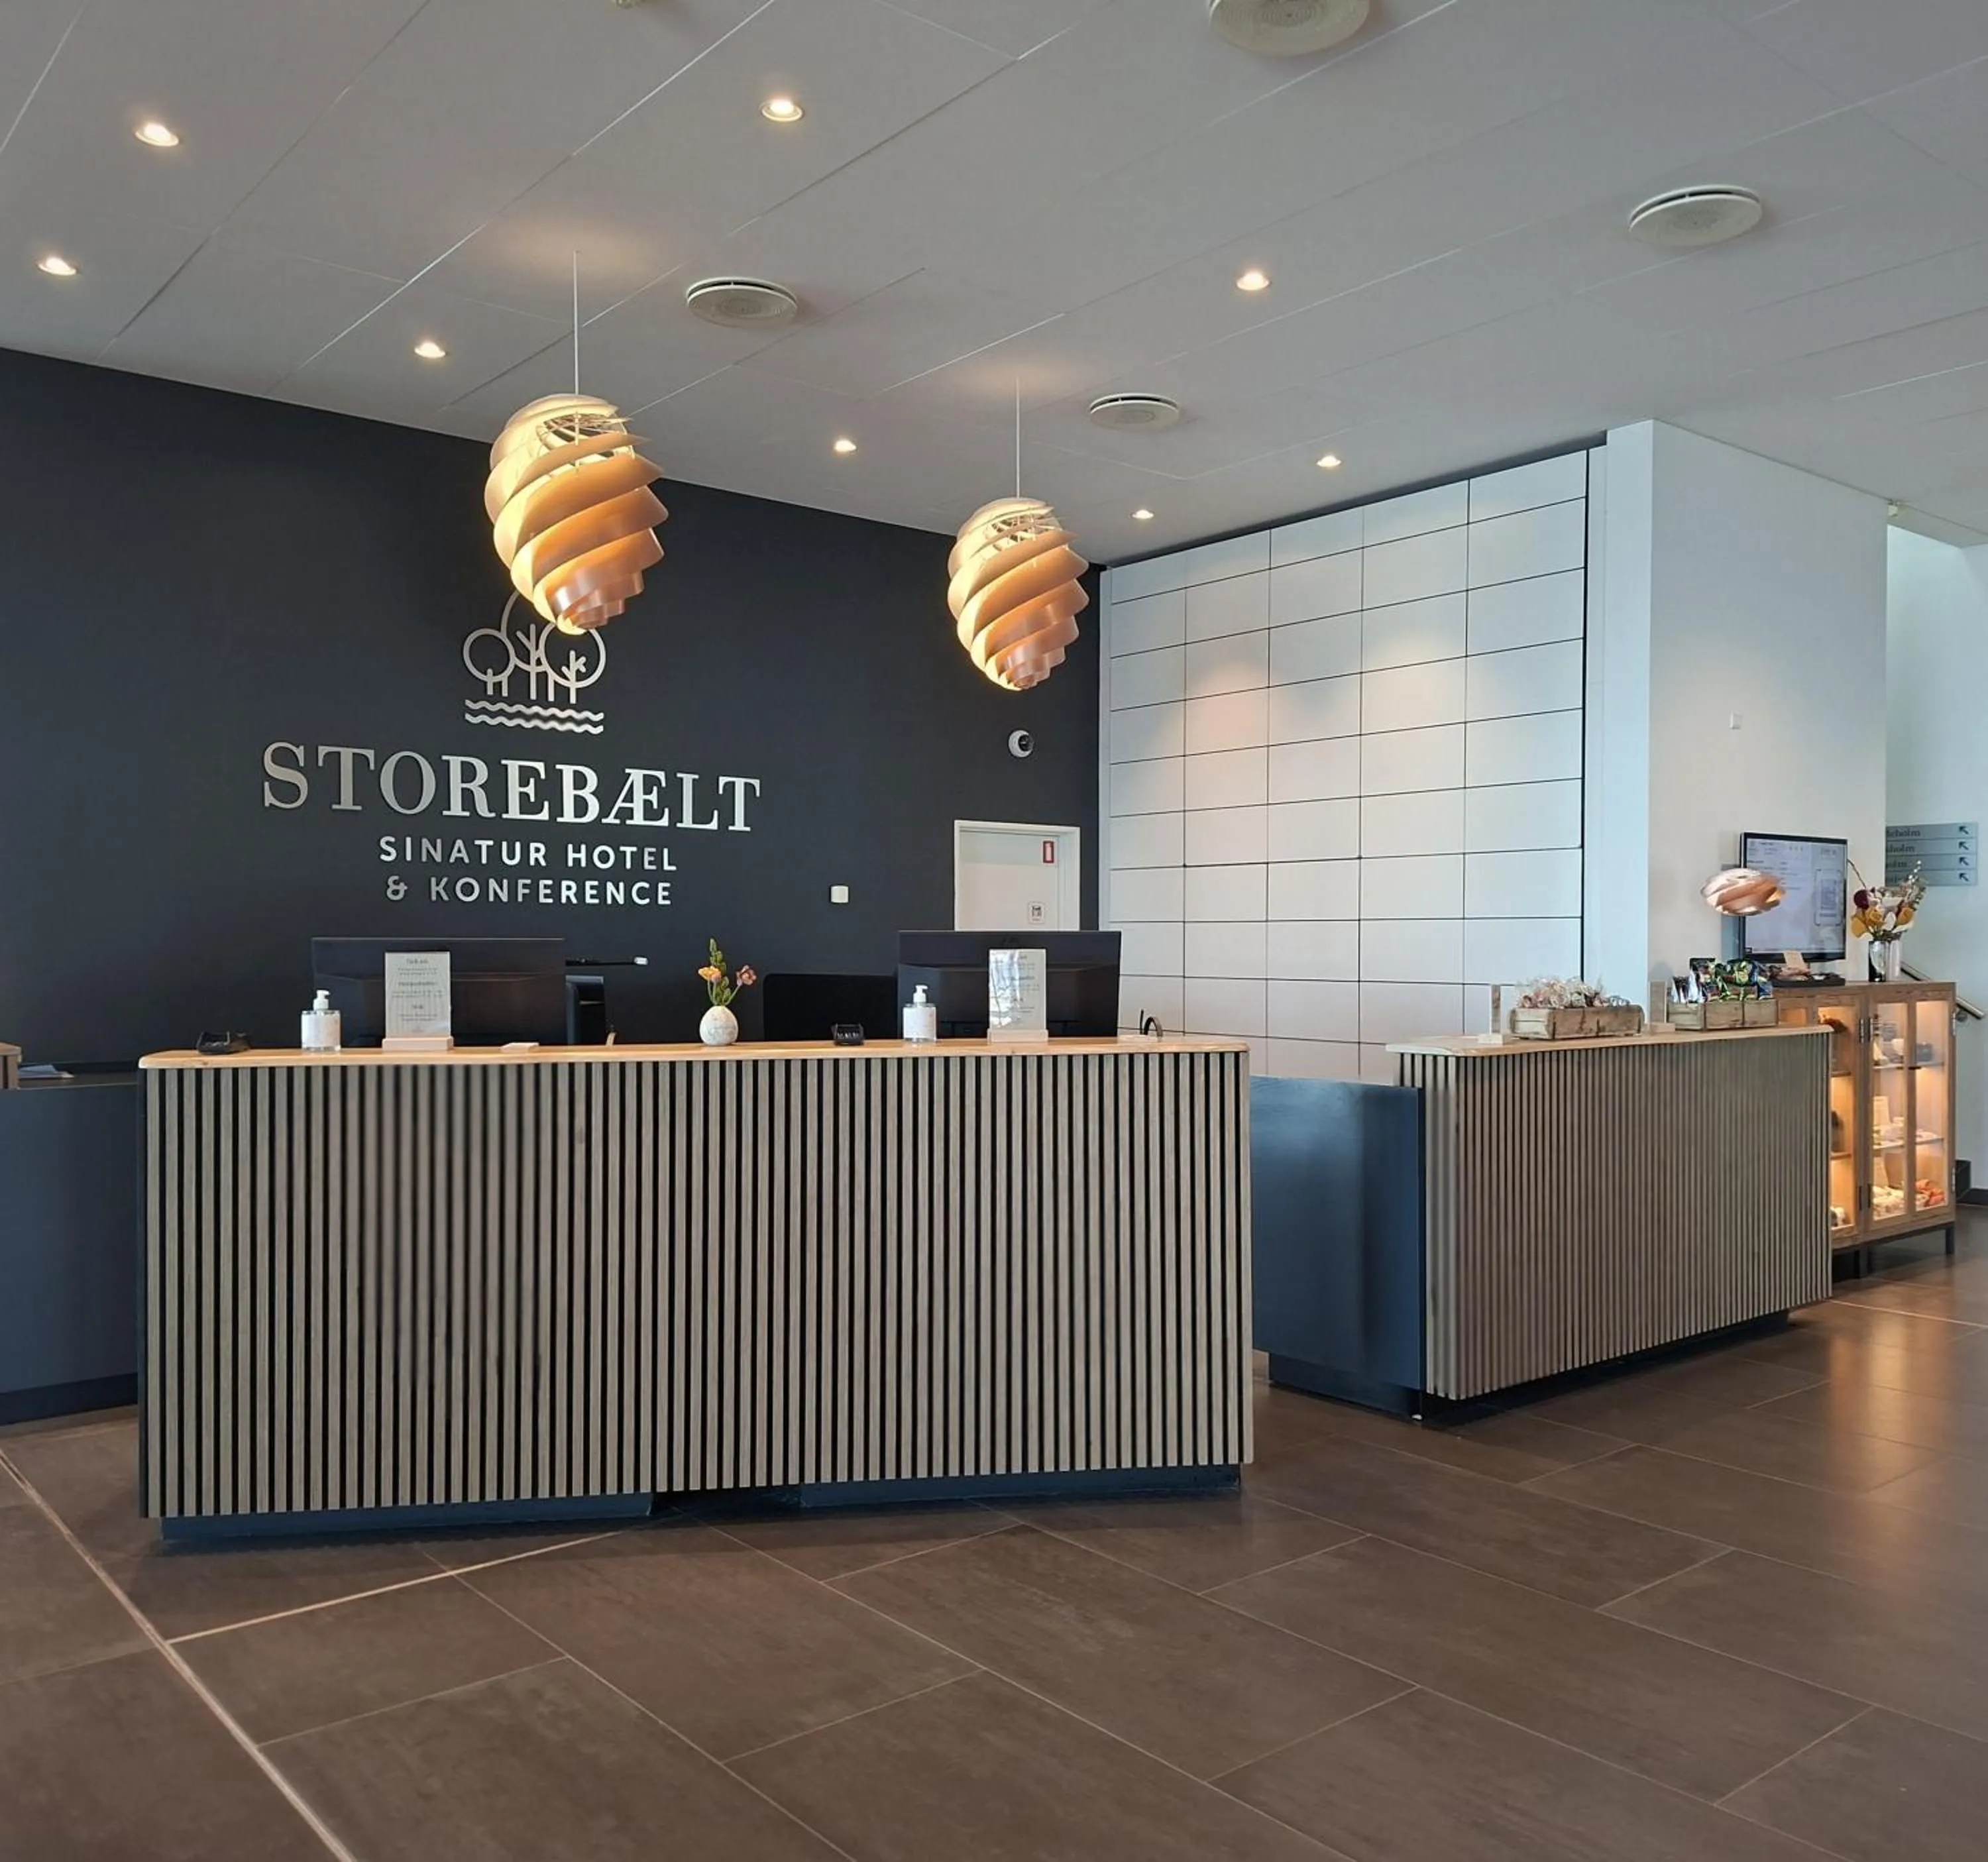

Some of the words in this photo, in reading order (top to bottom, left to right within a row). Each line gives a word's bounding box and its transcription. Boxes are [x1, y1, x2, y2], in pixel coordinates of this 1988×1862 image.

[262, 741, 761, 832] STOREBÆLT
[379, 836, 547, 867] SINATUR
[567, 843, 678, 871] HOTEL
[386, 875, 409, 901] &
[430, 876, 672, 906] KONFERENCE
